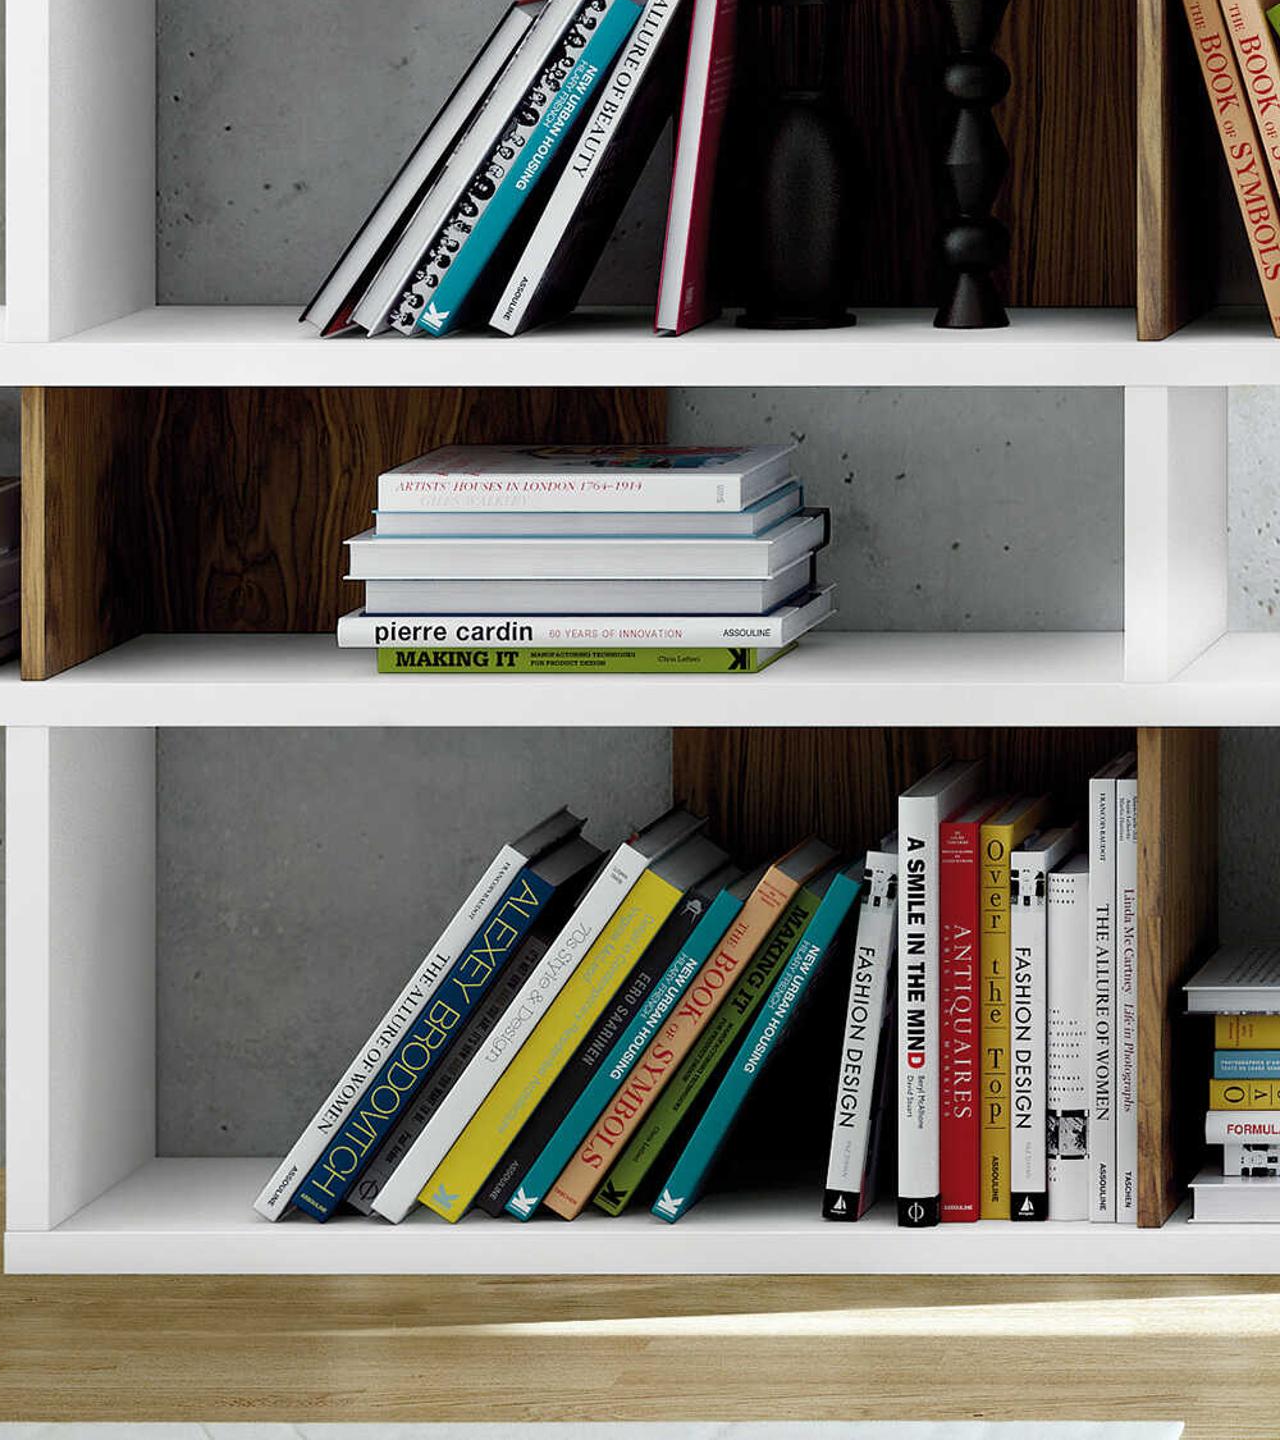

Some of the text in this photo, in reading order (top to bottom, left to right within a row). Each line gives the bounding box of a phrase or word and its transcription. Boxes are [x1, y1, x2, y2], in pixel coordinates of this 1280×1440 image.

[612, 71, 633, 100] OF
[1200, 31, 1241, 116] BOOK
[1239, 33, 1280, 117] BOOK
[515, 65, 598, 190] NEW URBAN HOUSING
[572, 100, 619, 179] BEAUTY
[453, 481, 503, 492] HOUSES
[505, 481, 521, 492] IN
[523, 481, 576, 492] LONDON
[375, 621, 533, 644] pierre cardin
[395, 651, 519, 667] MAKING IT
[565, 629, 598, 638] YEARS
[601, 629, 614, 638] OF
[619, 629, 683, 638] INNOVATION
[723, 629, 771, 637] ASSOULINE
[748, 905, 810, 990] MAKING
[907, 837, 925, 1069] A SMILE IN THE MIND
[986, 839, 1004, 1124] Over the Top
[584, 972, 651, 1066] EERO SAARINEN
[609, 958, 698, 1080] NEW URBAN HOUSING
[732, 988, 754, 1015] IT
[743, 944, 820, 1073] NEW URBAN HOUSING
[849, 946, 875, 1041] FASHION
[950, 925, 973, 1118] ANTIQUAIRES
[1015, 948, 1032, 1041] FASHION
[1096, 904, 1110, 1121] THE ALLURE OF WOMEN
[312, 879, 539, 1198] ALEXEY BRODOVITCH
[317, 952, 451, 1134] THE ALLURE OF WOMEN
[581, 923, 750, 1170] THE BOOK OF SYMBOLS
[839, 1048, 863, 1128] DESIGN
[1015, 1050, 1032, 1129] DESIGN
